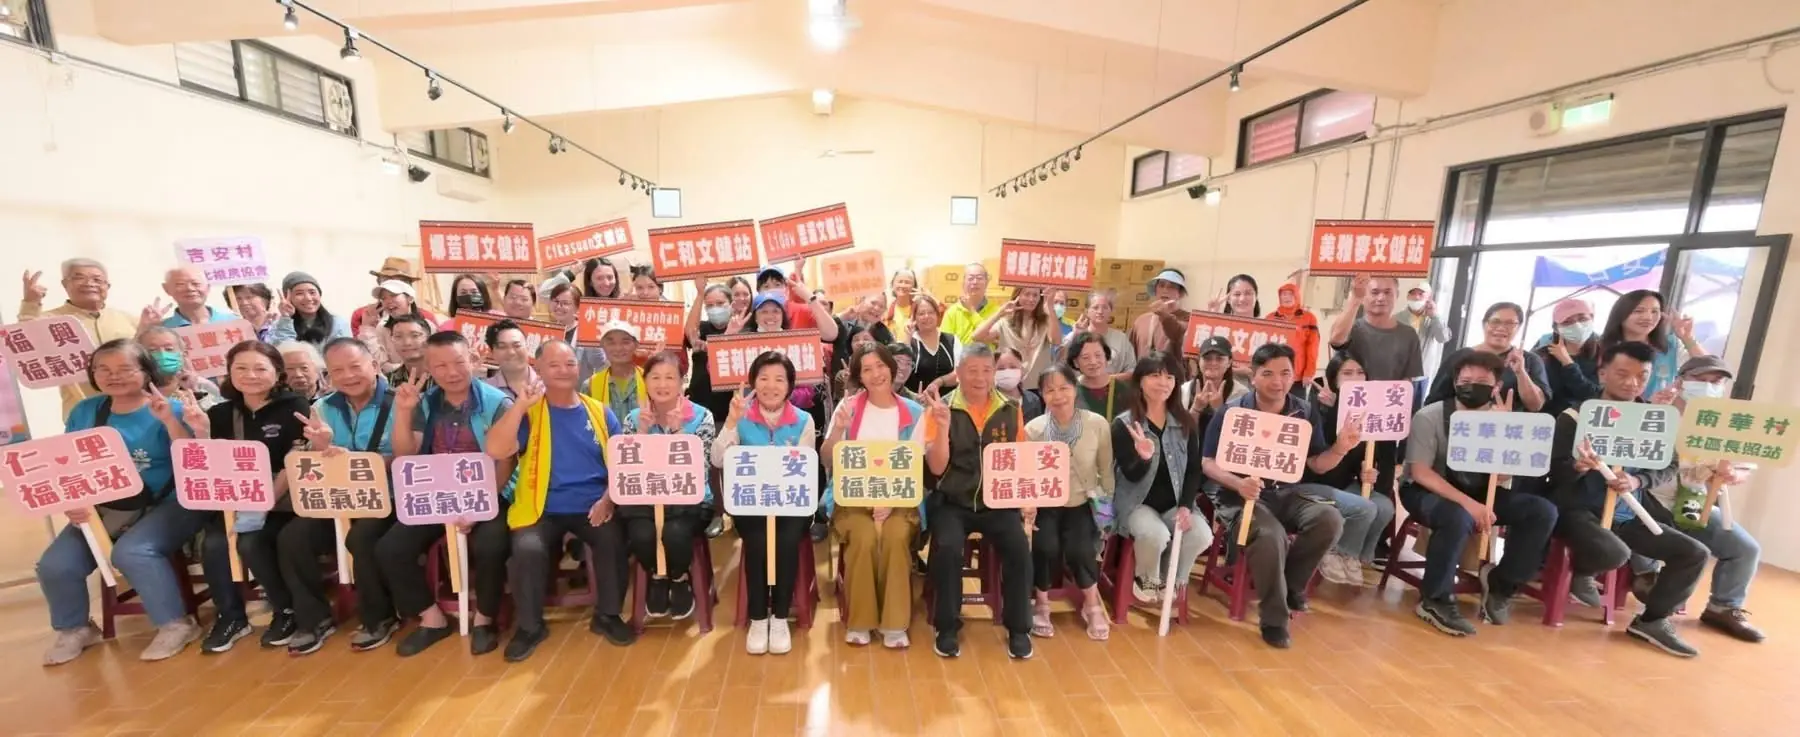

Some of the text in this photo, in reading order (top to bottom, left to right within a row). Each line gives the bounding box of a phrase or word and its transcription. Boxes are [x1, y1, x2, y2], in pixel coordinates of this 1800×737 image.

[184, 243, 253, 263] 吉安村
[658, 233, 753, 269] 仁和文健站
[626, 308, 680, 325] Pahanhan
[4, 322, 80, 354] 福興
[17, 350, 93, 381] 福氣站
[1347, 385, 1405, 407] 永安
[1232, 413, 1299, 446] 東昌
[1452, 421, 1552, 441] 光華城鄉
[1588, 406, 1665, 433] 北昌
[1696, 409, 1790, 436] 南華村
[5, 433, 115, 477] 仁里
[182, 445, 260, 471] 慶豐
[617, 440, 693, 465] 宜昌
[841, 446, 913, 470] 稻香
[991, 447, 1061, 471] 勝安
[1224, 441, 1299, 475] 福氣站
[1450, 446, 1549, 468] 發展協會
[1685, 434, 1783, 460] 社區長照站
[296, 457, 375, 481] 太昌
[402, 459, 484, 486] 仁和
[733, 451, 808, 477] 吉安
[18, 464, 133, 508] 福氣站
[184, 477, 266, 502] 福氣站
[617, 472, 697, 496] 福氣站
[731, 483, 810, 507] 福氣站
[841, 476, 916, 499] 福氣站
[991, 477, 1063, 500] 福氣站
[299, 488, 384, 510] 福氣站
[404, 489, 490, 516] 福氣站
